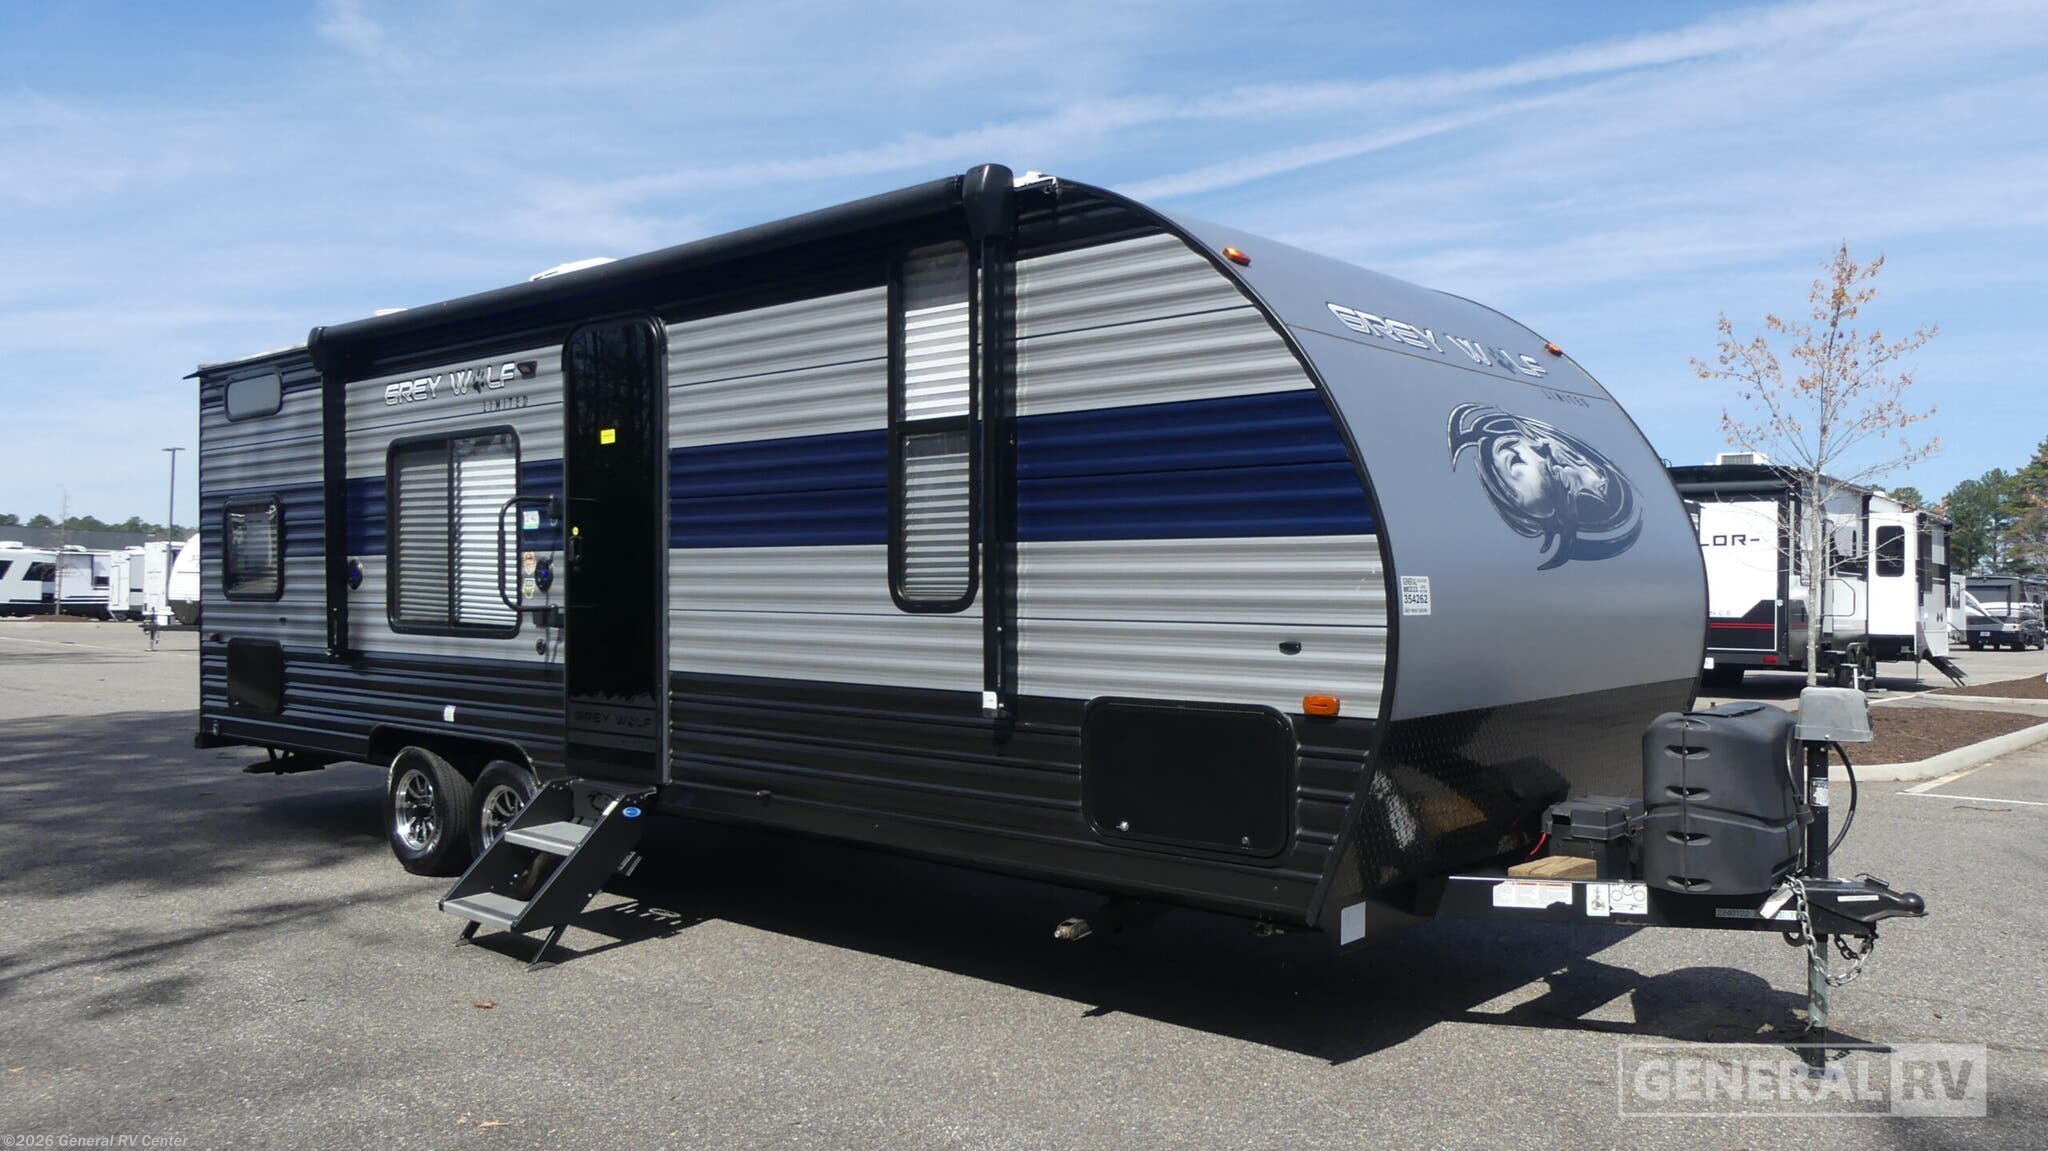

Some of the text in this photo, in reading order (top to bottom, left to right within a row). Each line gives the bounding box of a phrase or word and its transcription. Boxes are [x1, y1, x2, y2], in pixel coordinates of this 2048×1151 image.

[1326, 301, 1445, 354] GREY
[384, 373, 443, 406] GREY
[1541, 389, 1590, 408] LIMITED
[483, 395, 529, 413] LIMITED
[1404, 594, 1428, 604] 354262
[575, 711, 609, 723] GREY
